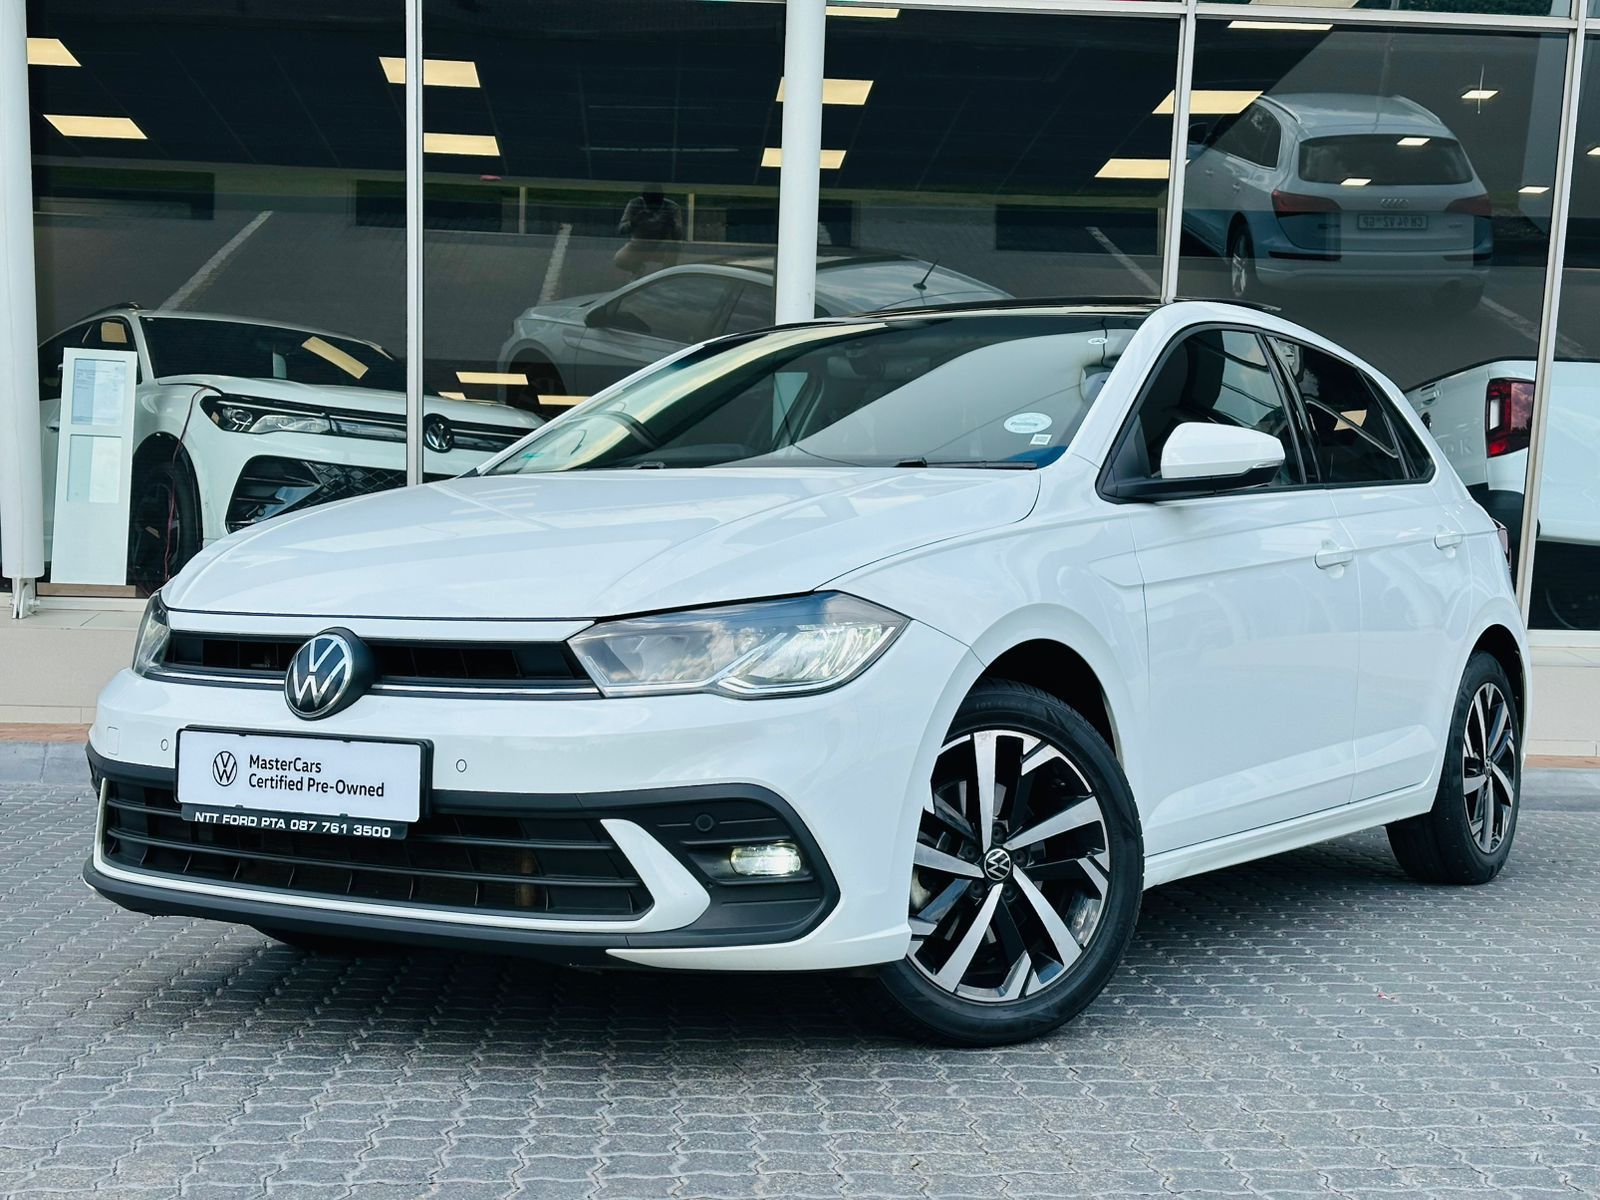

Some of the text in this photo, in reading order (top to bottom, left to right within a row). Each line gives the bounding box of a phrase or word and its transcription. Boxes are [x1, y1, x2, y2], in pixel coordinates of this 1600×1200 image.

[212, 750, 238, 787] VW
[249, 754, 322, 773] MasterCars
[249, 773, 384, 797] Certified Pre-Owned
[194, 811, 391, 838] NTT FORD PTA 087 761 3500
